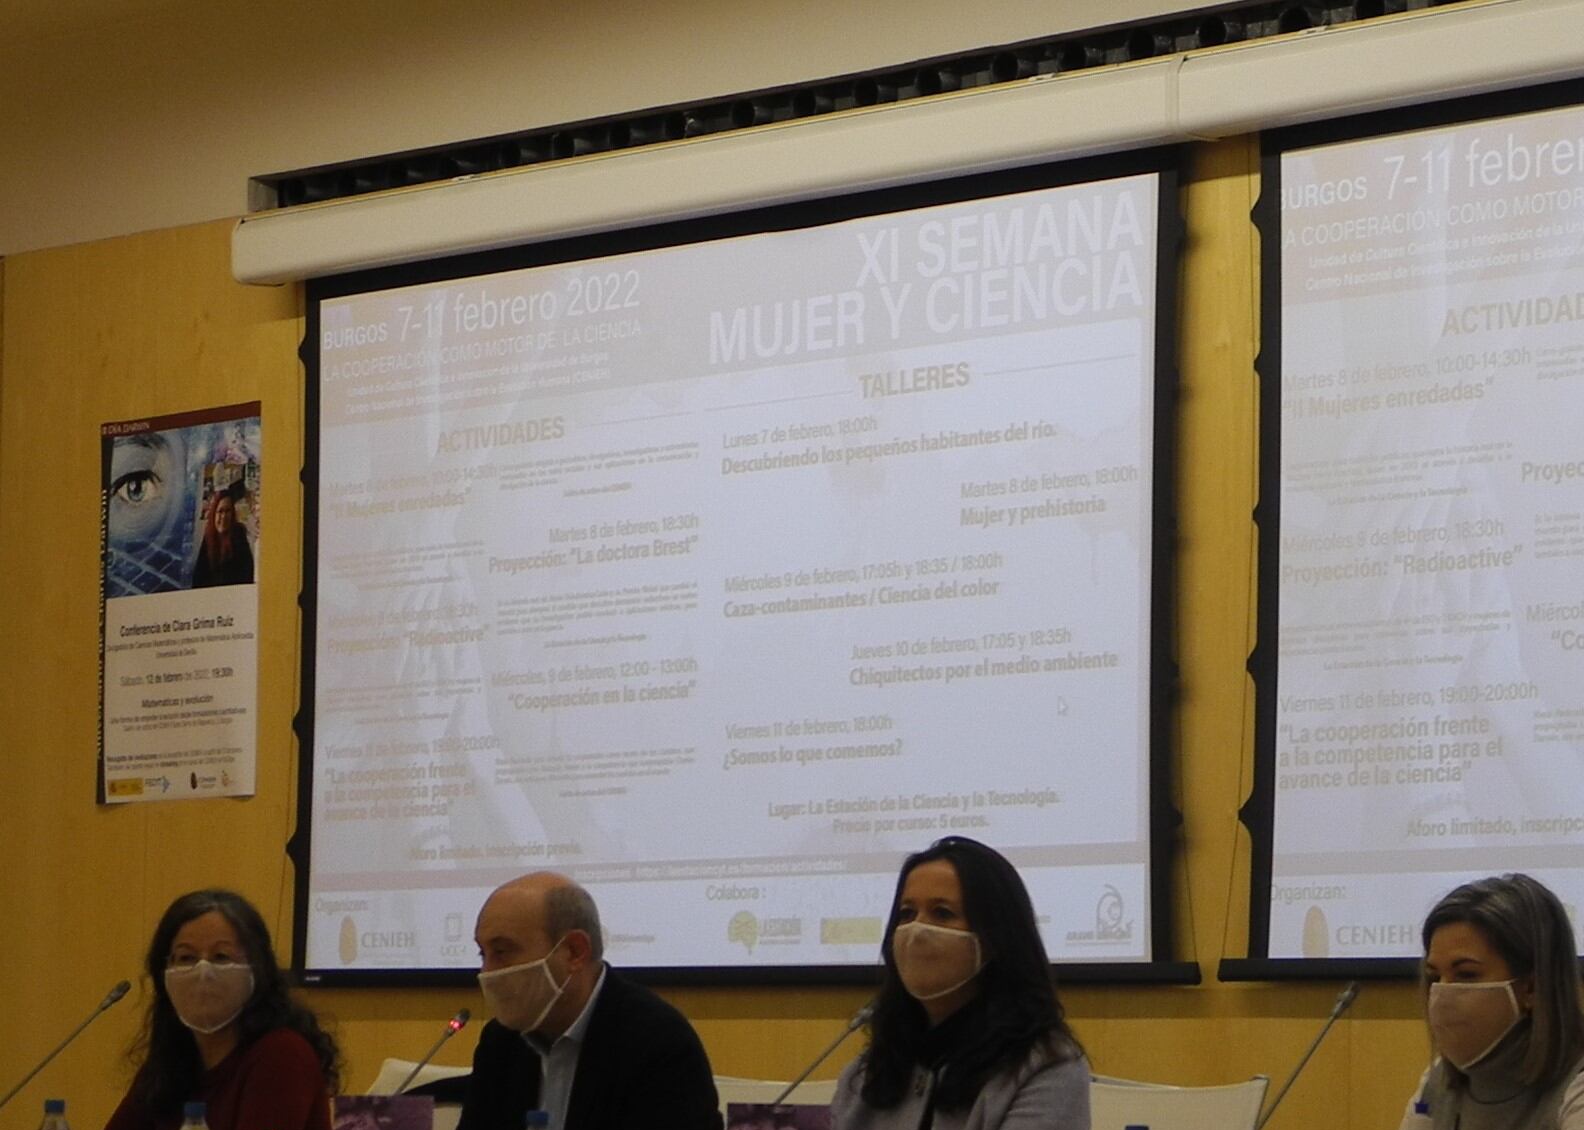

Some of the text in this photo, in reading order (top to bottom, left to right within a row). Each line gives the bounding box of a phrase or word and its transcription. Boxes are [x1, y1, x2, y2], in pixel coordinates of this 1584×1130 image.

[1382, 146, 1452, 201] 7-11
[855, 190, 1145, 288] XI SEMANA
[1300, 206, 1442, 247] COOPERACIÓN
[1445, 197, 1508, 226] COMO
[323, 268, 641, 350] BURGOS 7-11 febrero 2022
[708, 249, 1144, 365] MUJER Y CIENCIA
[858, 361, 971, 399] TALLERES
[436, 415, 566, 454] ACTIVIDADES
[721, 447, 820, 476] Descubriendo
[821, 446, 843, 464] los
[845, 437, 919, 464] pequeños
[920, 429, 1002, 452] habitantes
[1003, 420, 1028, 443] del
[1031, 420, 1058, 439] río.
[849, 651, 1119, 689] Chiquitectos por el medio ambiente
[722, 747, 778, 772] ¿Somos
[778, 745, 794, 763] lo
[795, 748, 824, 767] que
[824, 737, 904, 761] comemos?
[1406, 818, 1447, 837] Aforo
[1450, 816, 1517, 836] limitado,
[361, 931, 416, 949] CENIEH
[1336, 923, 1414, 945] CENIEH
